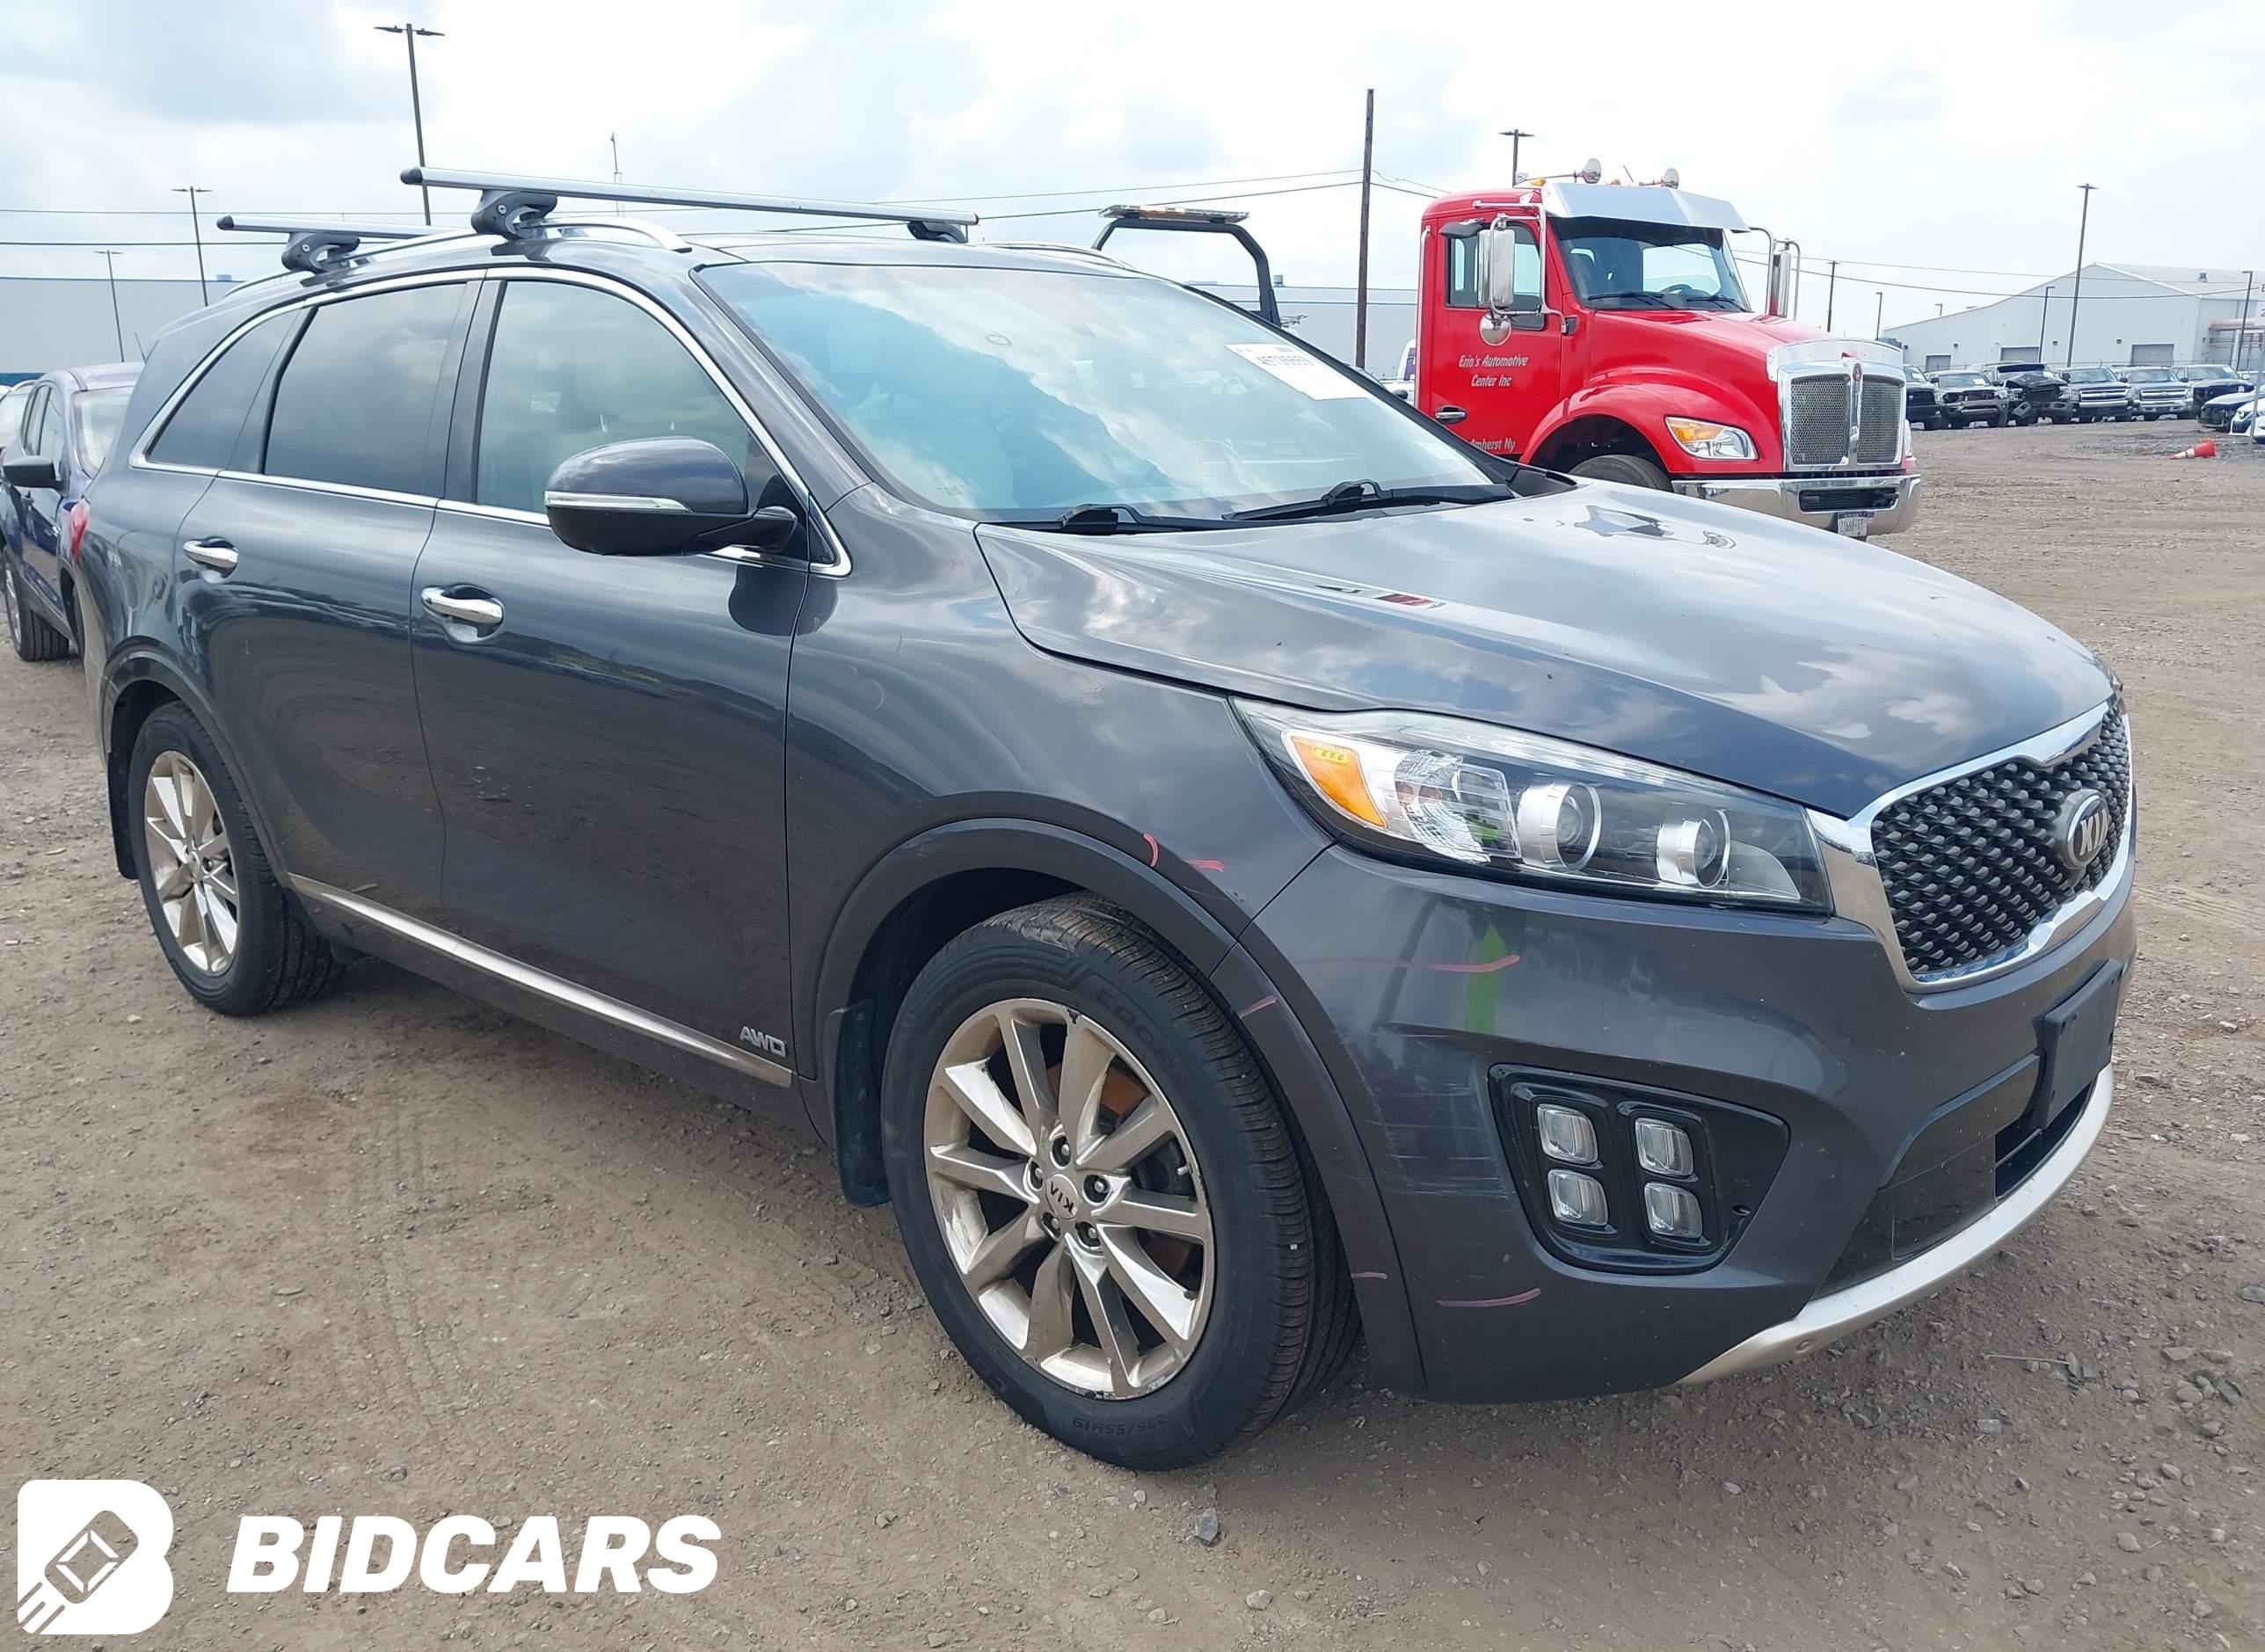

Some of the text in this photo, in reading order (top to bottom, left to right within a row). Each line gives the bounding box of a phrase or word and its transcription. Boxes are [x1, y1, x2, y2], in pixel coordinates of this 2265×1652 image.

[1459, 353, 1528, 368] Erin's Automotive
[1471, 374, 1511, 387] Center Inc
[2079, 808, 2108, 856] KIA
[739, 1025, 786, 1058] AWD
[1049, 1181, 1074, 1214] KIA
